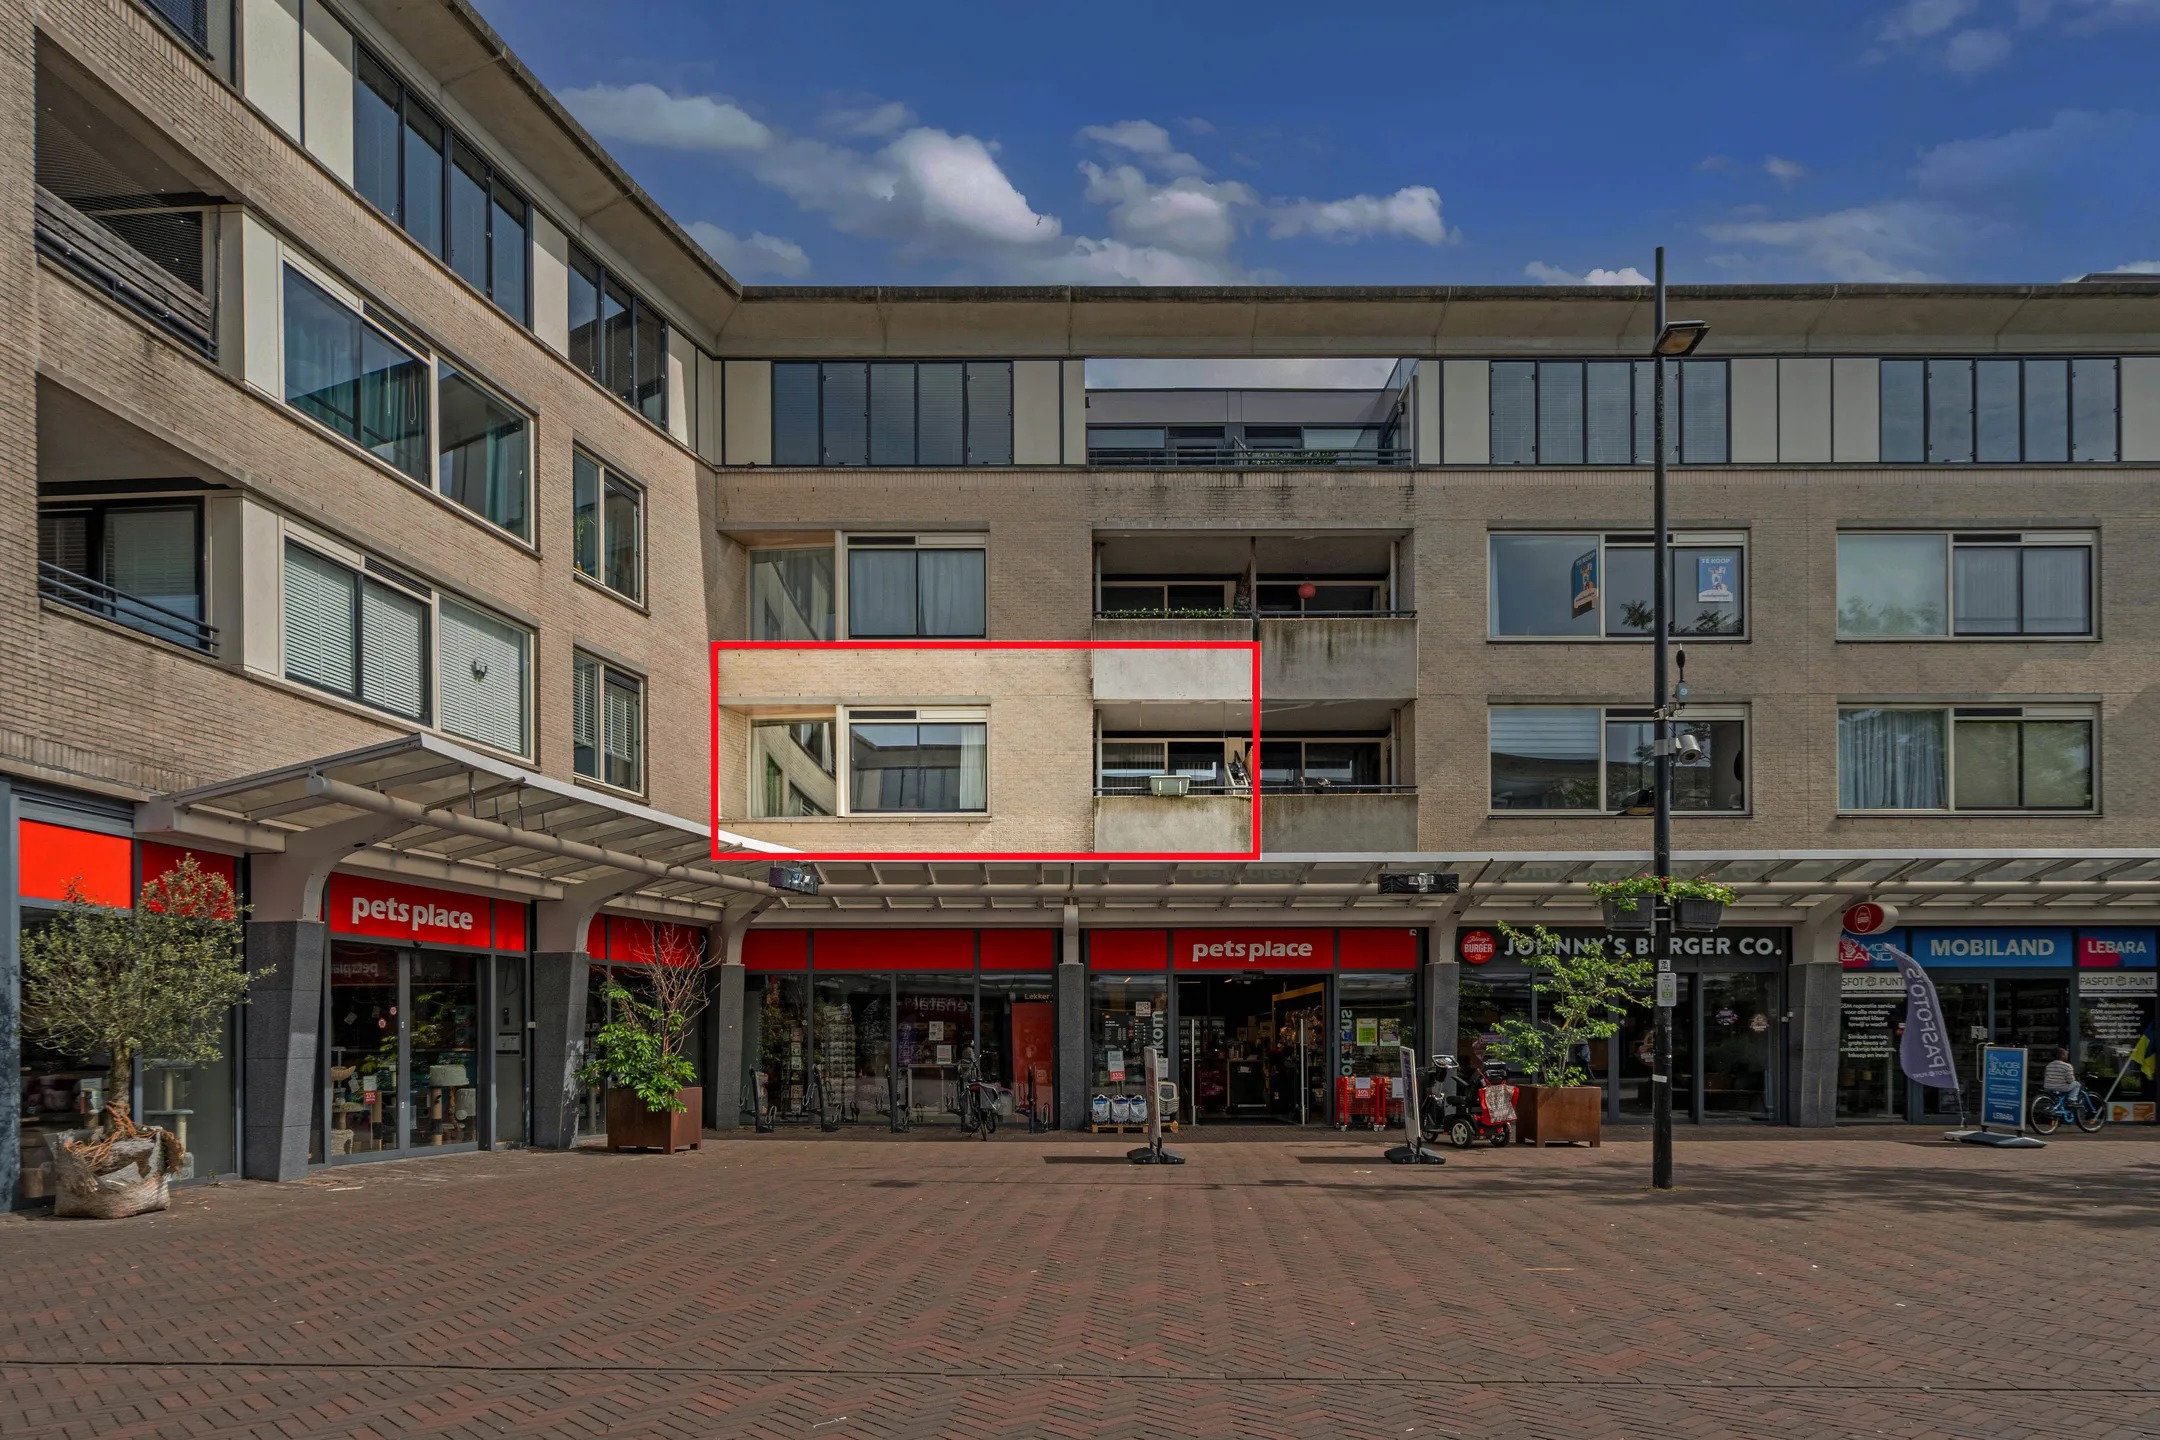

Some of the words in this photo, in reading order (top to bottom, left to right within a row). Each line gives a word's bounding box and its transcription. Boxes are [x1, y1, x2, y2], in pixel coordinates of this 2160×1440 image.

[352, 897, 410, 925] pets
[412, 903, 474, 931] place
[1192, 940, 1246, 962] pets
[1248, 940, 1313, 962] place
[1464, 943, 1493, 953] BURGER
[1636, 937, 1731, 955] BRGER
[1739, 937, 1783, 955] CO.
[1930, 939, 2055, 956] MOBILAND
[2087, 940, 2147, 954] LEBARA
[1840, 952, 1893, 961] LAND
[1879, 977, 1904, 986] PUNT
[2129, 977, 2154, 986] PUNT
[1025, 993, 1050, 1002] Lekker
